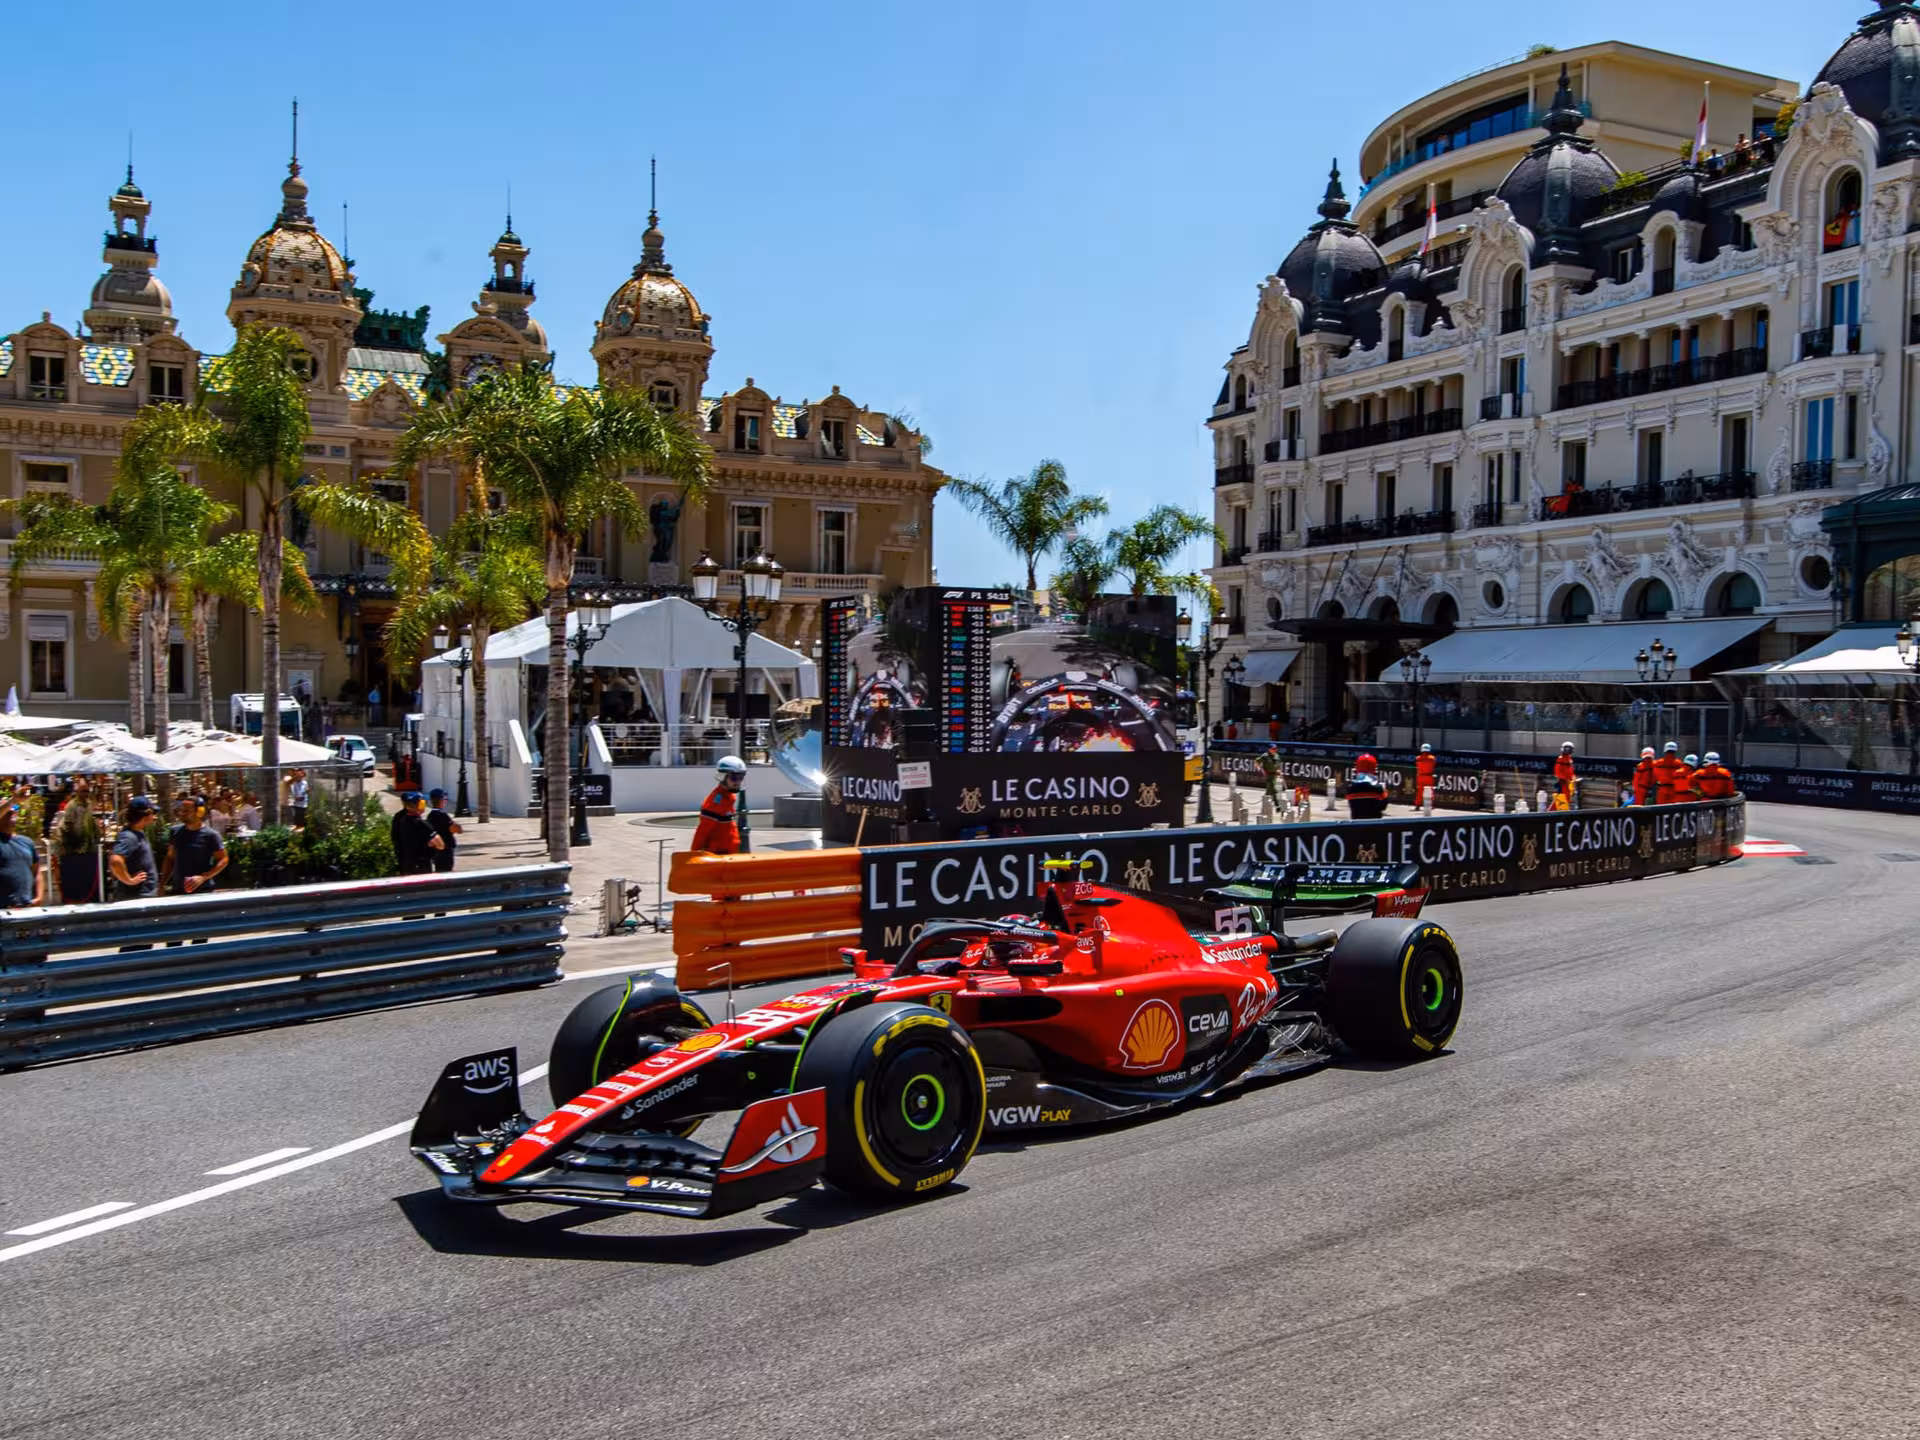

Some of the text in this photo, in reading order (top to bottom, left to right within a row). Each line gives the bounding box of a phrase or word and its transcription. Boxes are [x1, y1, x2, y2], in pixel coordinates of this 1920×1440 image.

[1292, 762, 1332, 780] CASINO
[1433, 774, 1478, 792] ASINO
[843, 776, 902, 802] LE CASINO
[992, 776, 1130, 802] LE CASINO
[1545, 817, 1635, 853] LE CASINO
[1655, 814, 1670, 842] LE
[1672, 808, 1715, 840] CASINO
[1387, 825, 1514, 864] LE CASINO
[1169, 843, 1204, 884] LE
[870, 862, 918, 910] LE
[1074, 883, 1092, 895] ZCG
[1394, 894, 1424, 906] V-Power
[1215, 906, 1253, 941] 55
[1077, 937, 1094, 948] aws
[1210, 942, 1262, 962] Santander
[464, 1056, 510, 1081] aws
[635, 1074, 699, 1113] Santander
[988, 1105, 1071, 1126] VGW PLAY
[651, 1178, 712, 1195] V-Pow
